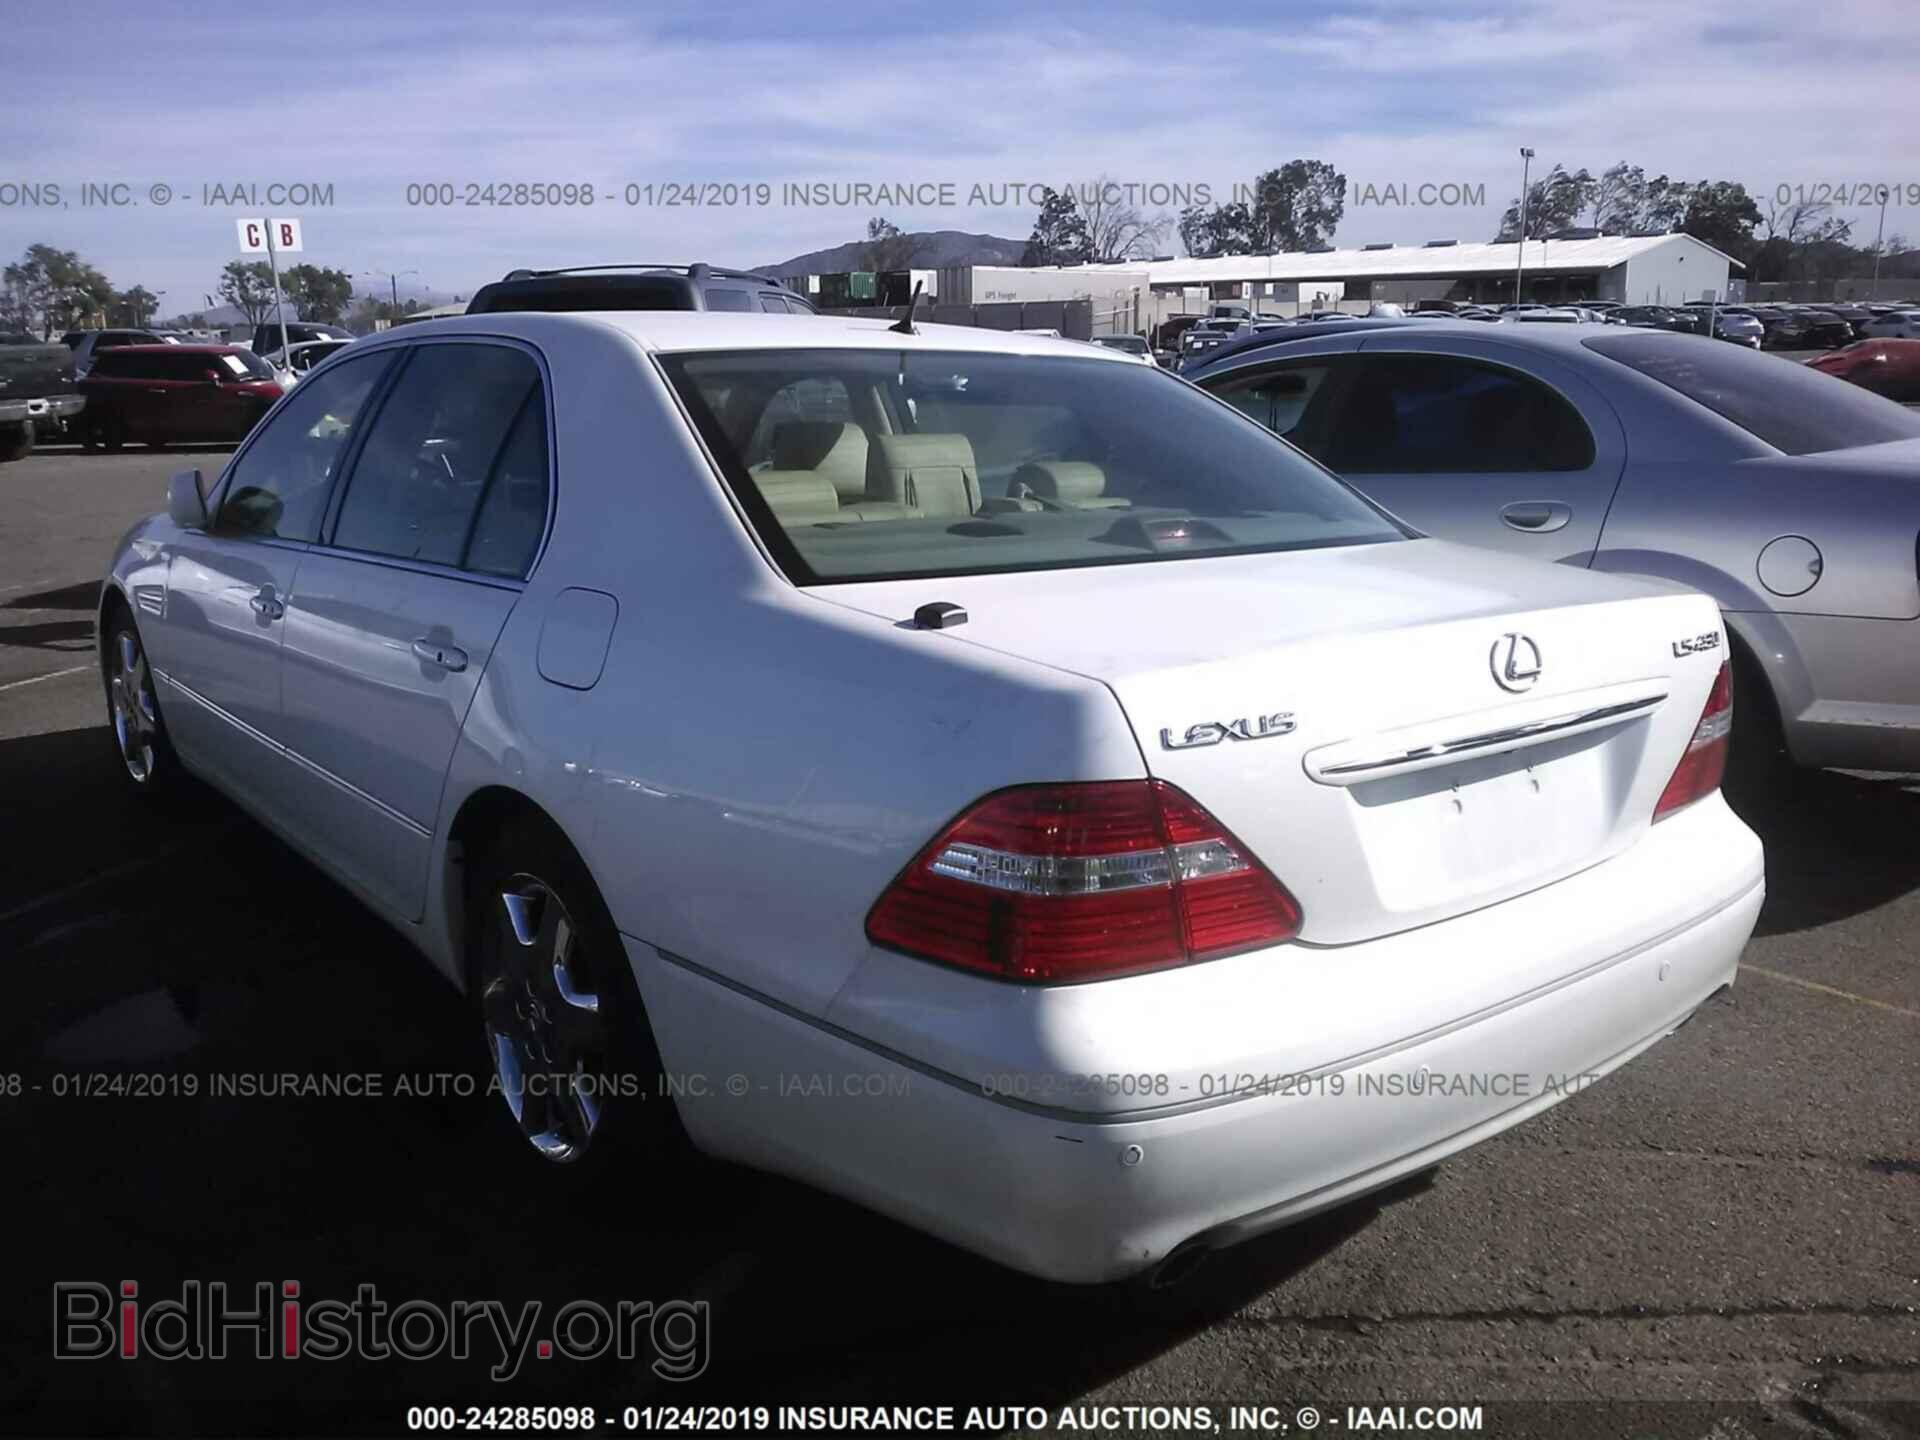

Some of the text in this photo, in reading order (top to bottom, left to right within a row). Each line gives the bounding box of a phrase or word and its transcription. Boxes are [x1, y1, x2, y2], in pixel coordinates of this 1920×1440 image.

[247, 223, 260, 247] C
[281, 223, 293, 246] B
[1159, 701, 1297, 751] LEXUS
